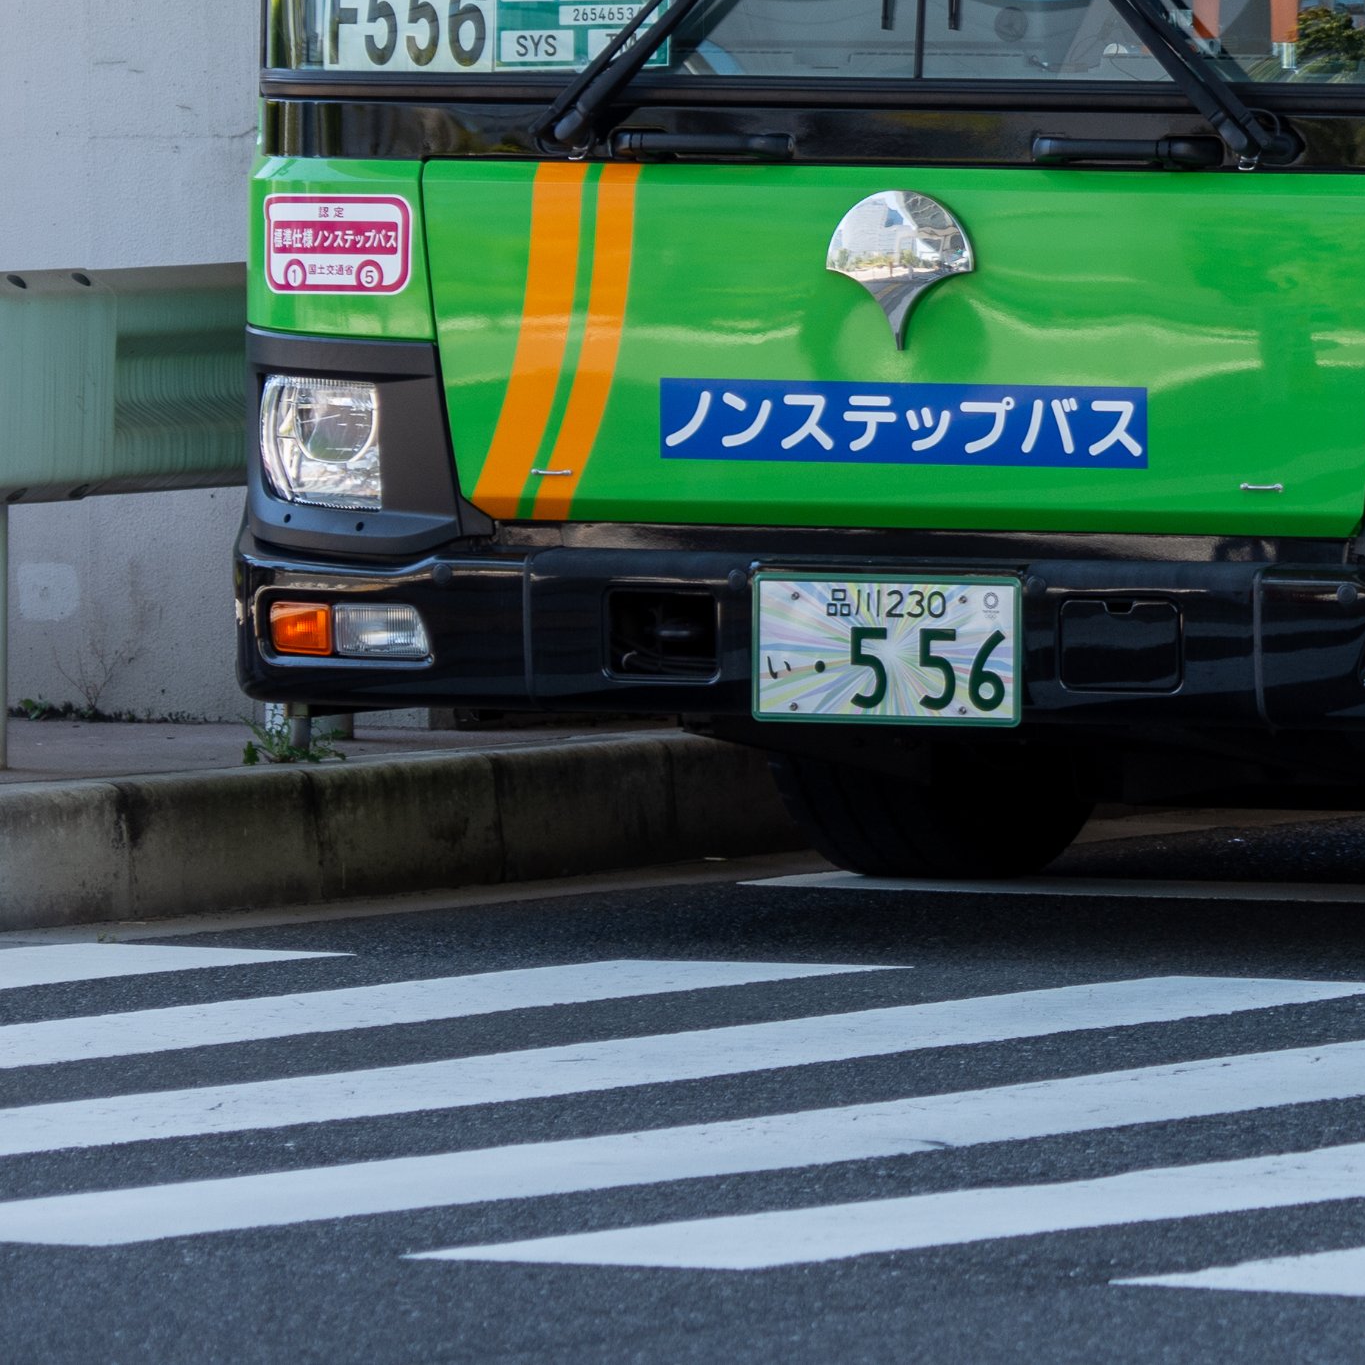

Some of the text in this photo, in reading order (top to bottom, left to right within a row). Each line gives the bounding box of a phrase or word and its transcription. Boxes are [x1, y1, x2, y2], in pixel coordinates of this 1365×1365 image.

[572, 7, 642, 22] 2654653
[515, 34, 558, 58] SYS
[318, 206, 344, 219] 認定
[273, 228, 398, 249] 標準仕様ノンステップバス
[308, 263, 354, 276] 国土交通省
[364, 270, 375, 284] 5
[665, 390, 1143, 458] ノンステップバス
[766, 656, 792, 680] い
